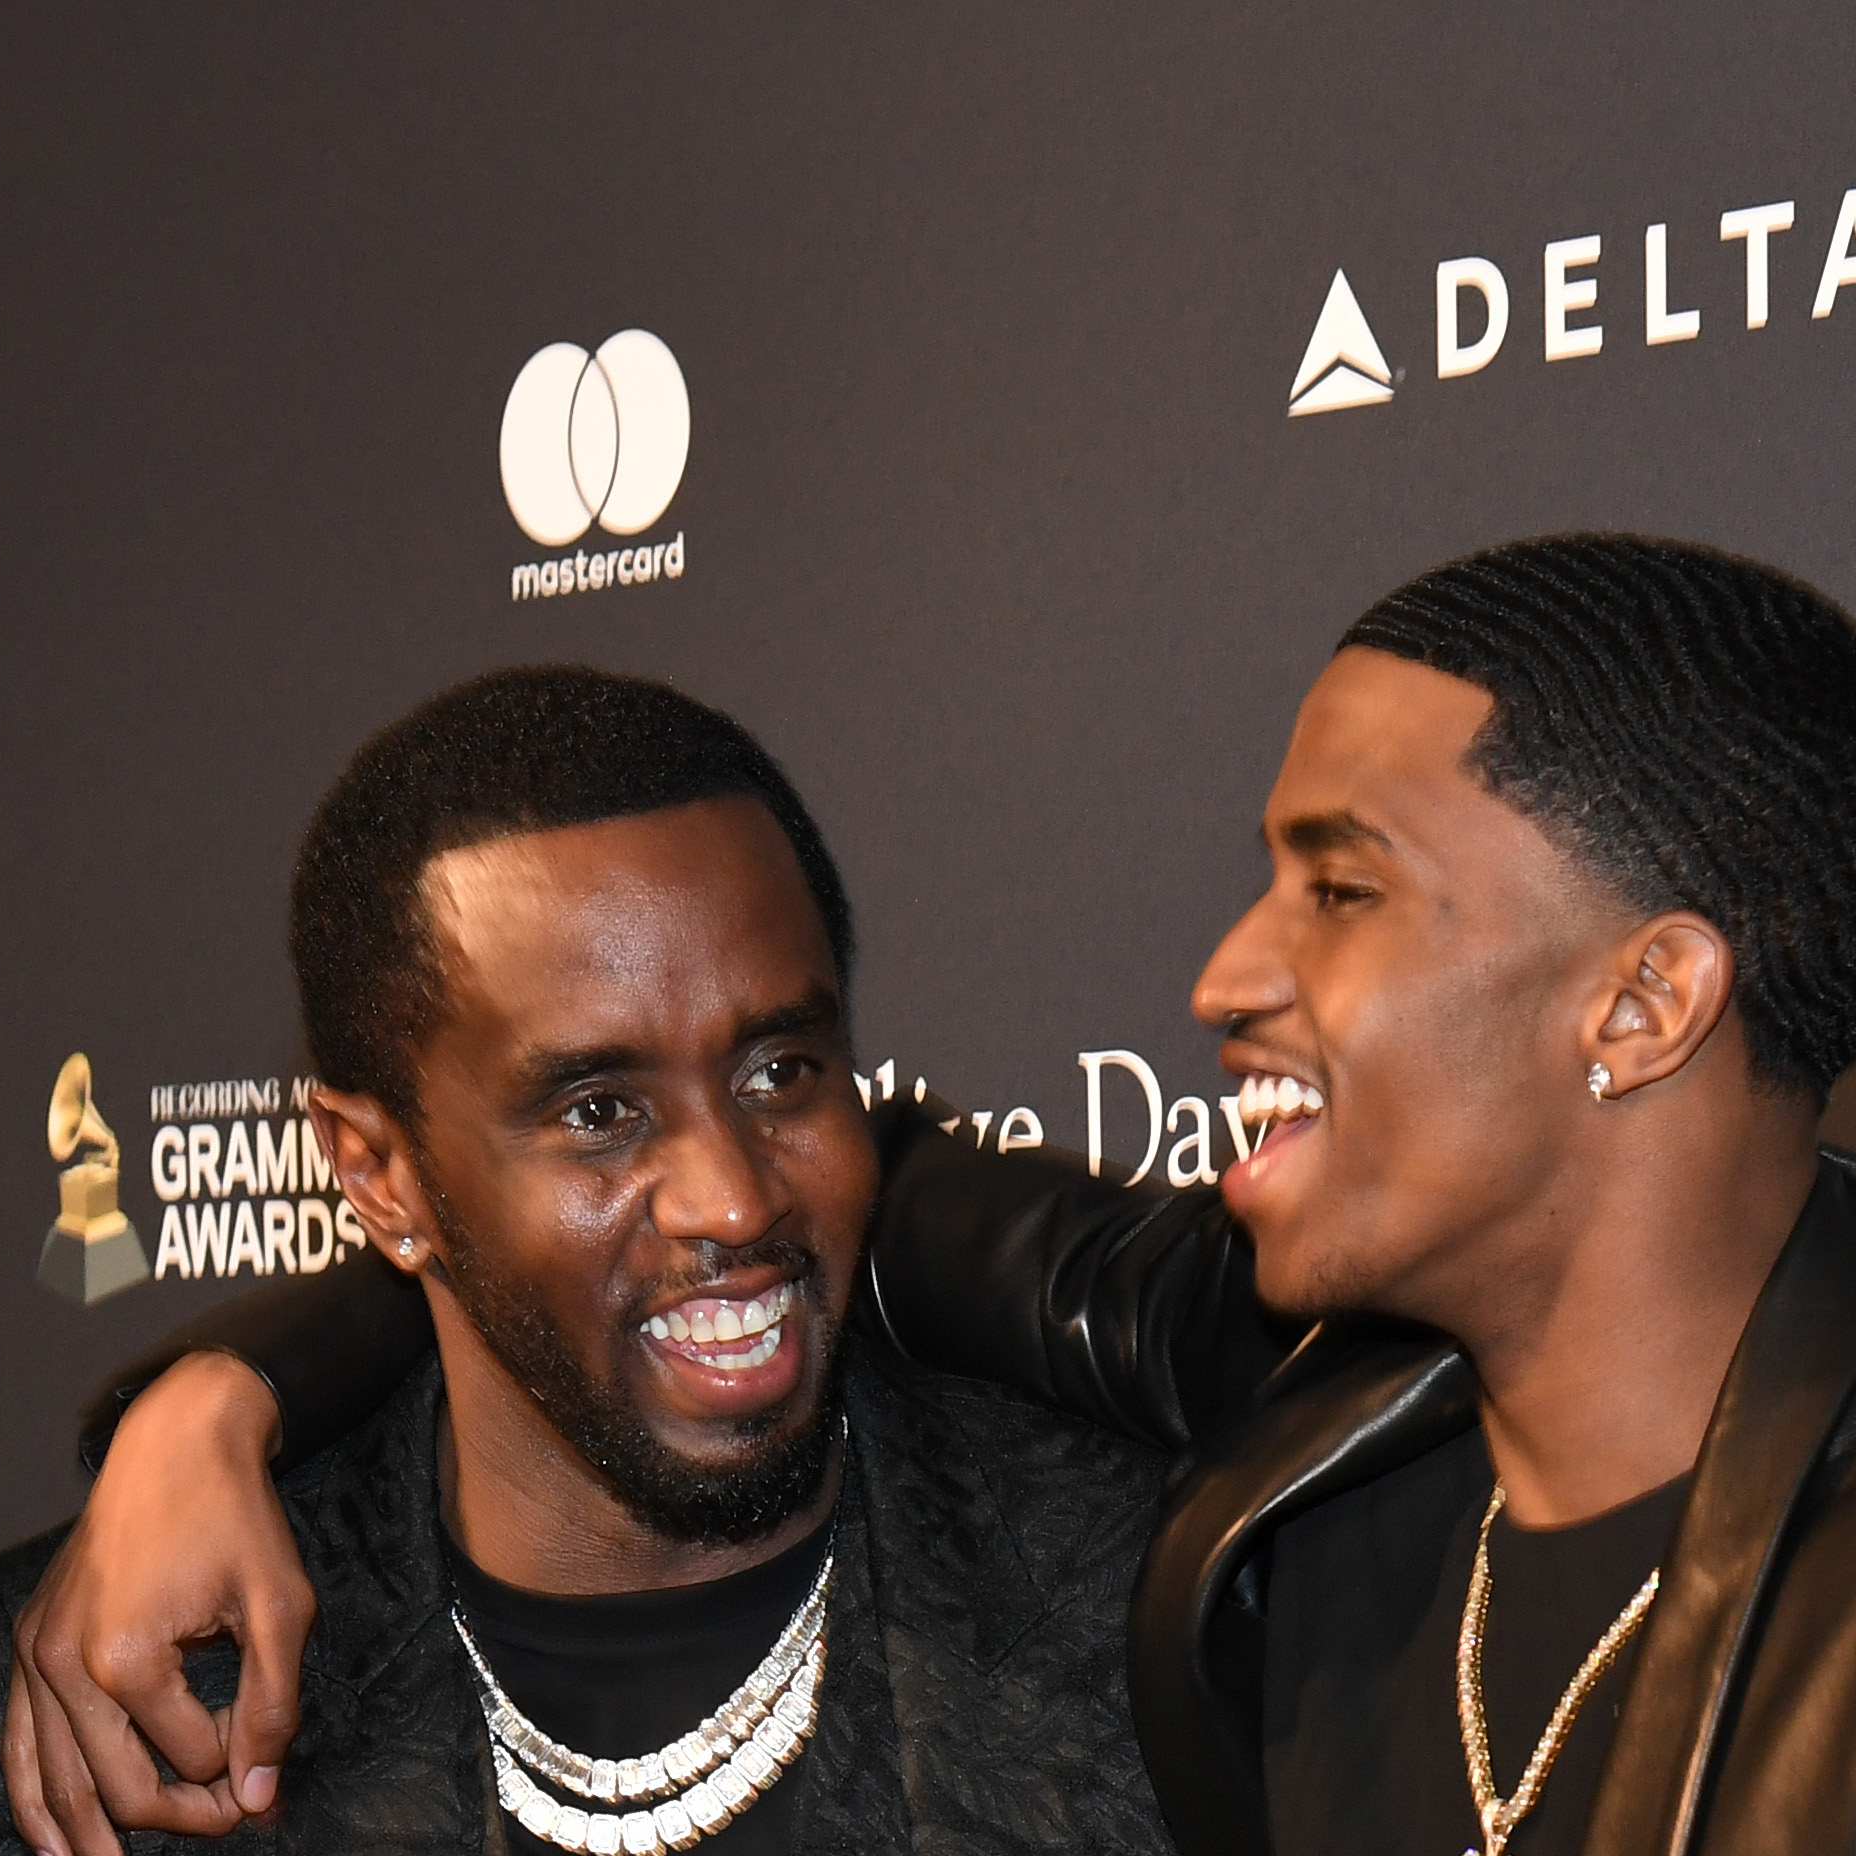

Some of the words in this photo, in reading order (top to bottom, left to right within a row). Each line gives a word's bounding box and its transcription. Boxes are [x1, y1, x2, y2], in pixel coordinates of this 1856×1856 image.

[512, 530, 685, 602] mastercard
[150, 1076, 281, 1122] RECORDING
[154, 1198, 367, 1281] AWARDS
